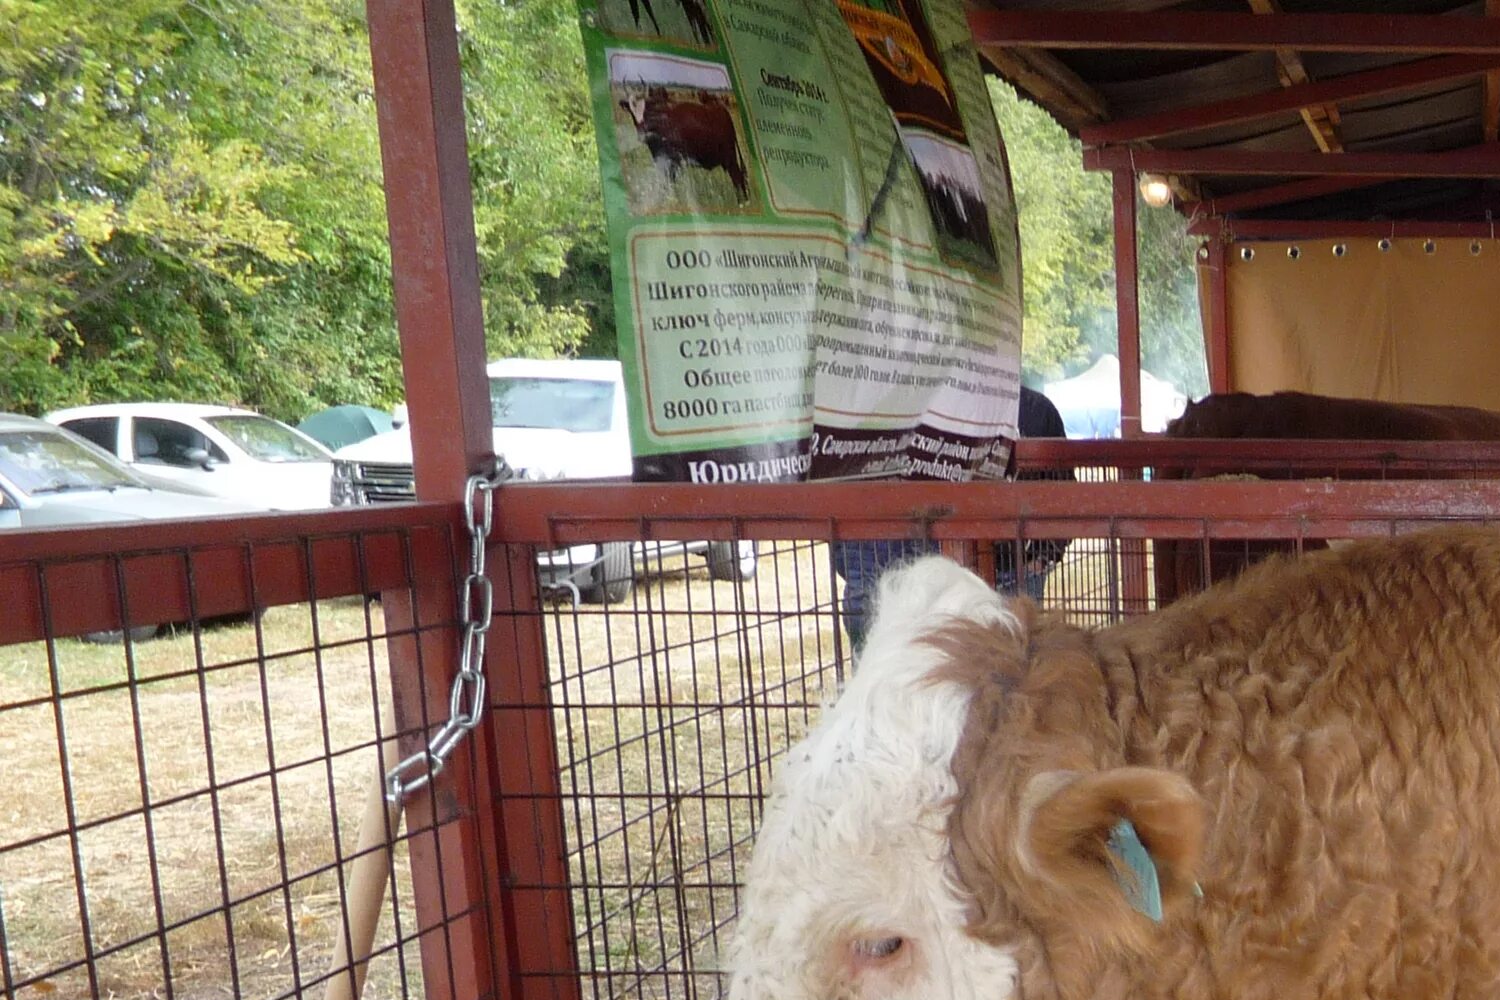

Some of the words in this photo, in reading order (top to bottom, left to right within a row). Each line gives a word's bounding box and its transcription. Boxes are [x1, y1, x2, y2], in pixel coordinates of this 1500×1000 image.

[666, 250, 711, 269] ООО
[715, 249, 799, 268] «Шигонский
[648, 281, 760, 300] Шигонского
[652, 312, 710, 331] ключ
[679, 340, 693, 359] С
[697, 337, 741, 357] 2014
[776, 333, 801, 351] ООО
[684, 367, 751, 388] Общее
[663, 398, 718, 420] 8000
[721, 399, 741, 415] га
